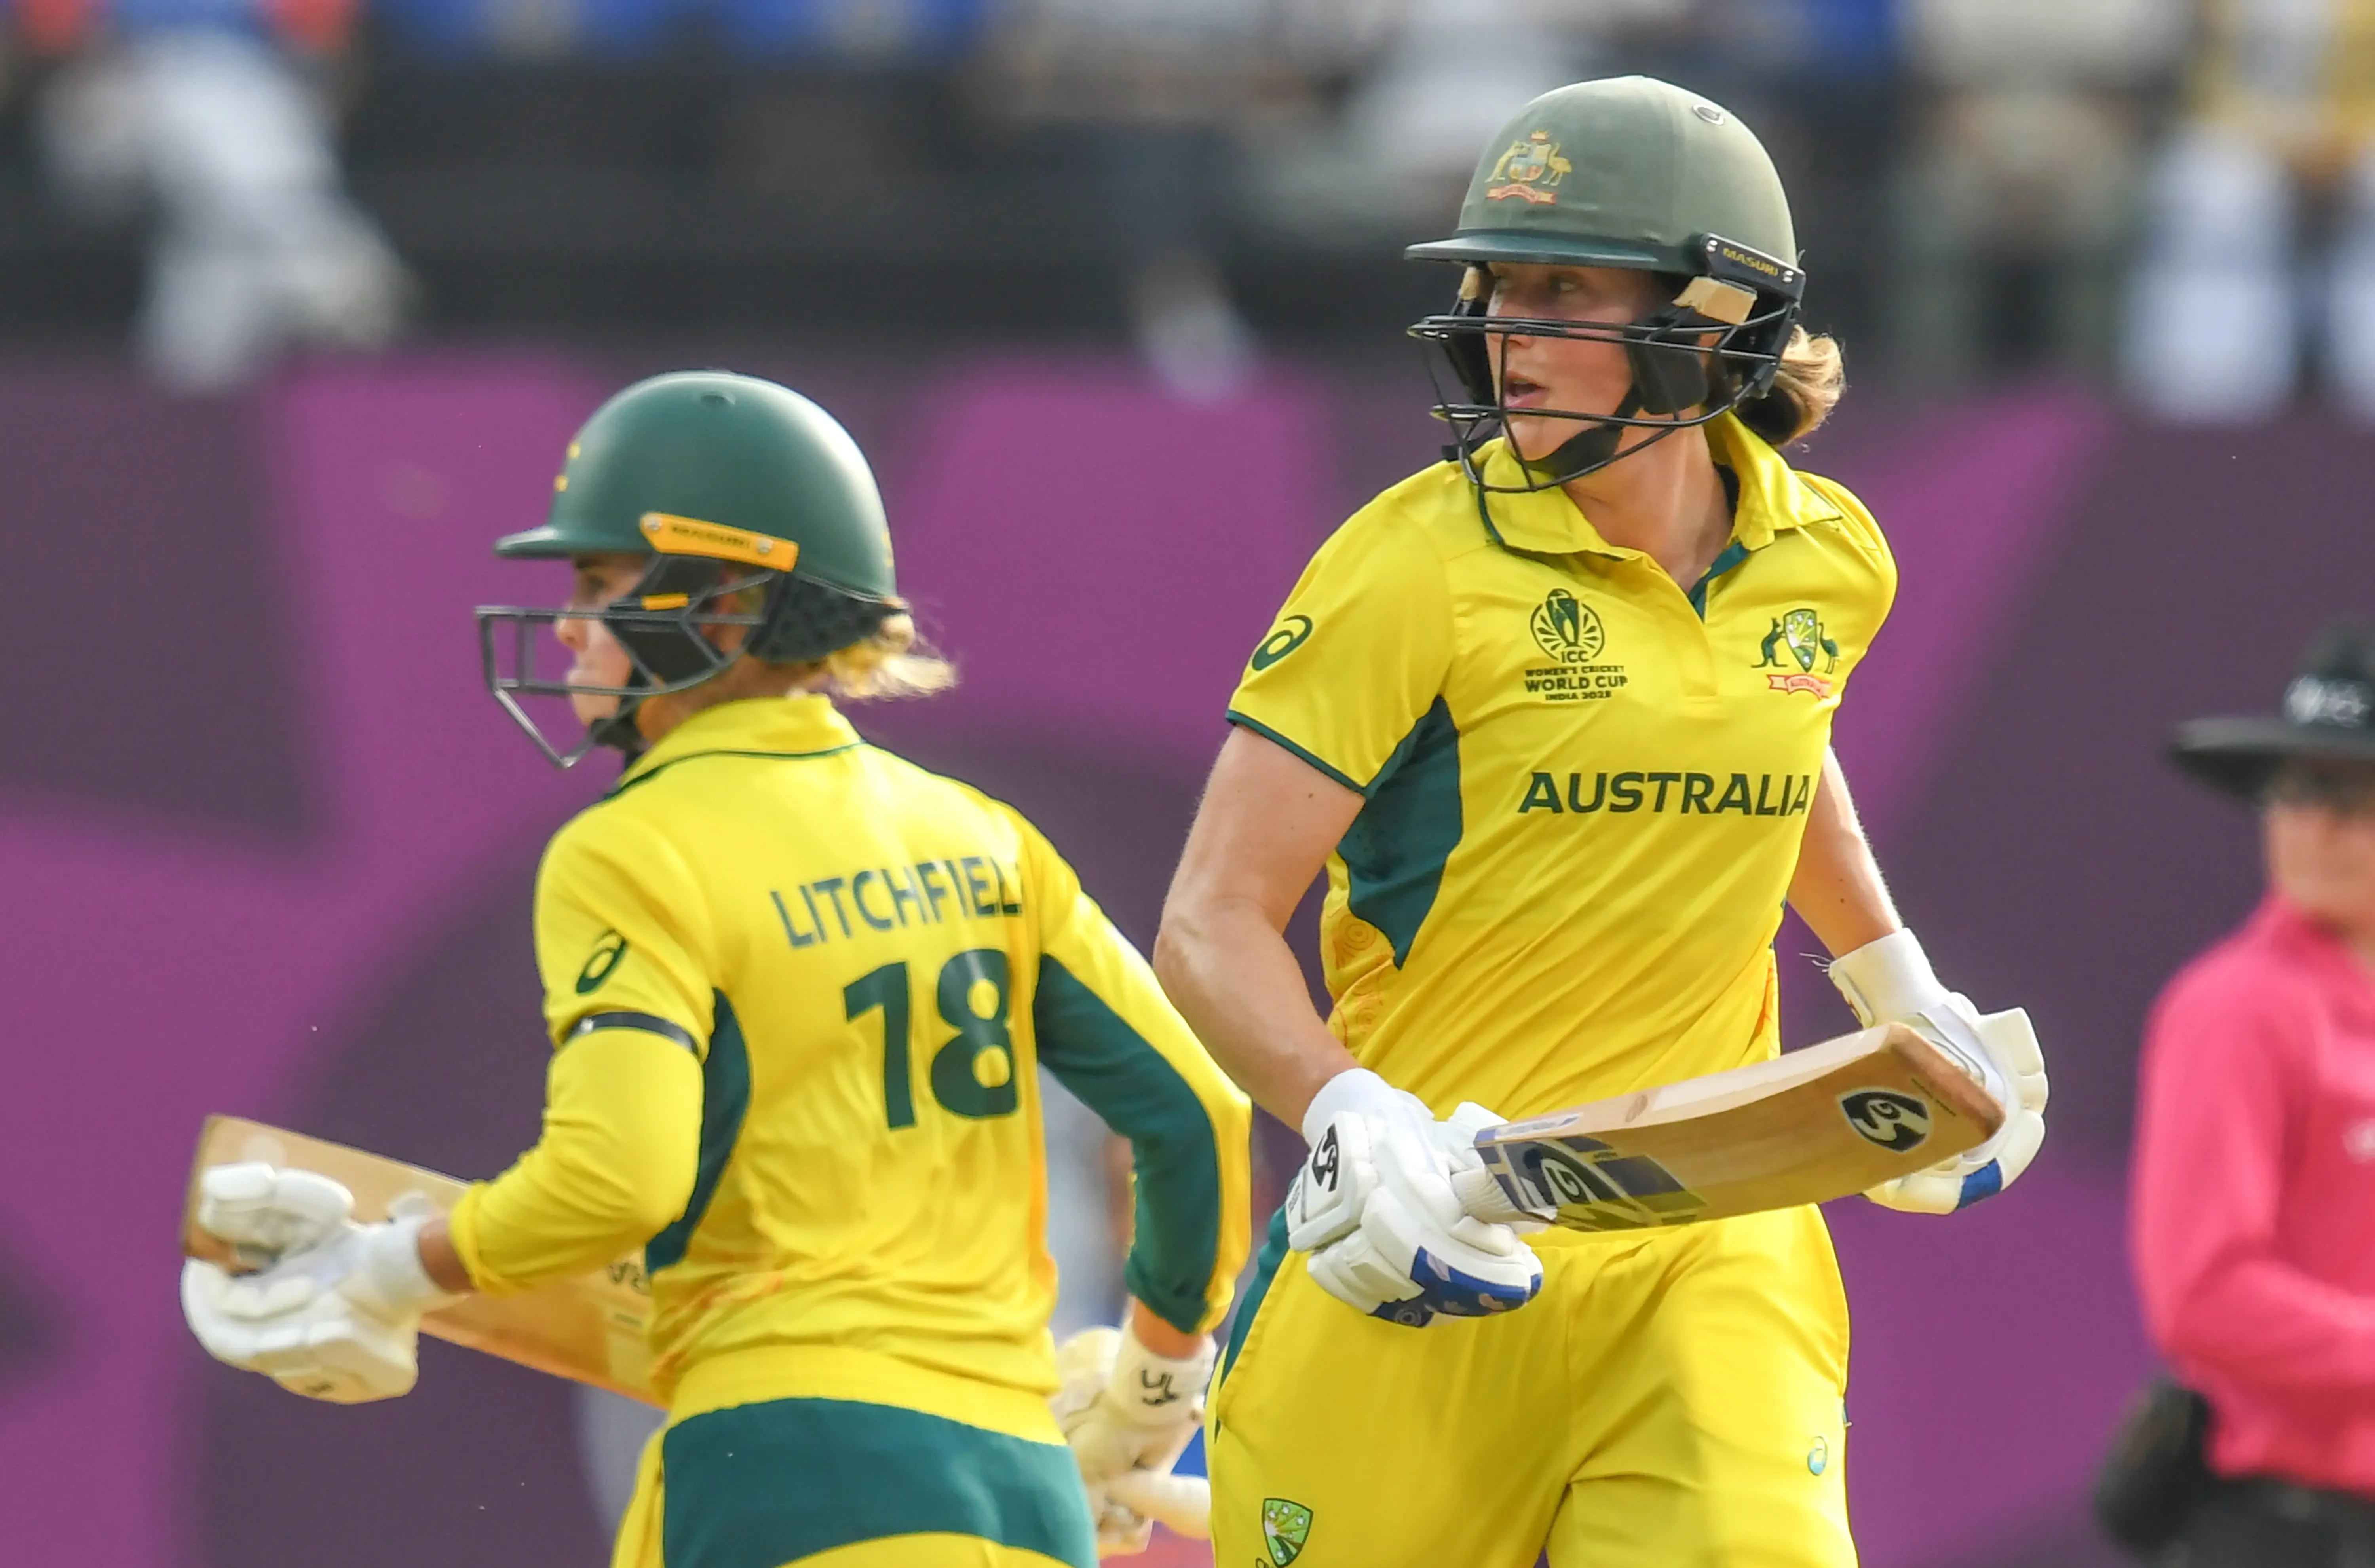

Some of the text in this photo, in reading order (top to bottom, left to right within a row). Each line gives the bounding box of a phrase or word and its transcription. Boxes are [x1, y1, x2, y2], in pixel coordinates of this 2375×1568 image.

[1723, 247, 1779, 277] MASURI
[1562, 651, 1589, 663] ICC
[1525, 665, 1624, 677] WOMEN'S CRICKET
[1525, 675, 1628, 692] WORLD CUP
[1545, 693, 1579, 701] INDIA
[1518, 772, 1810, 816] AUSTRALIA
[770, 856, 1022, 948] LITCHFIEL
[844, 948, 1020, 1131] 18
